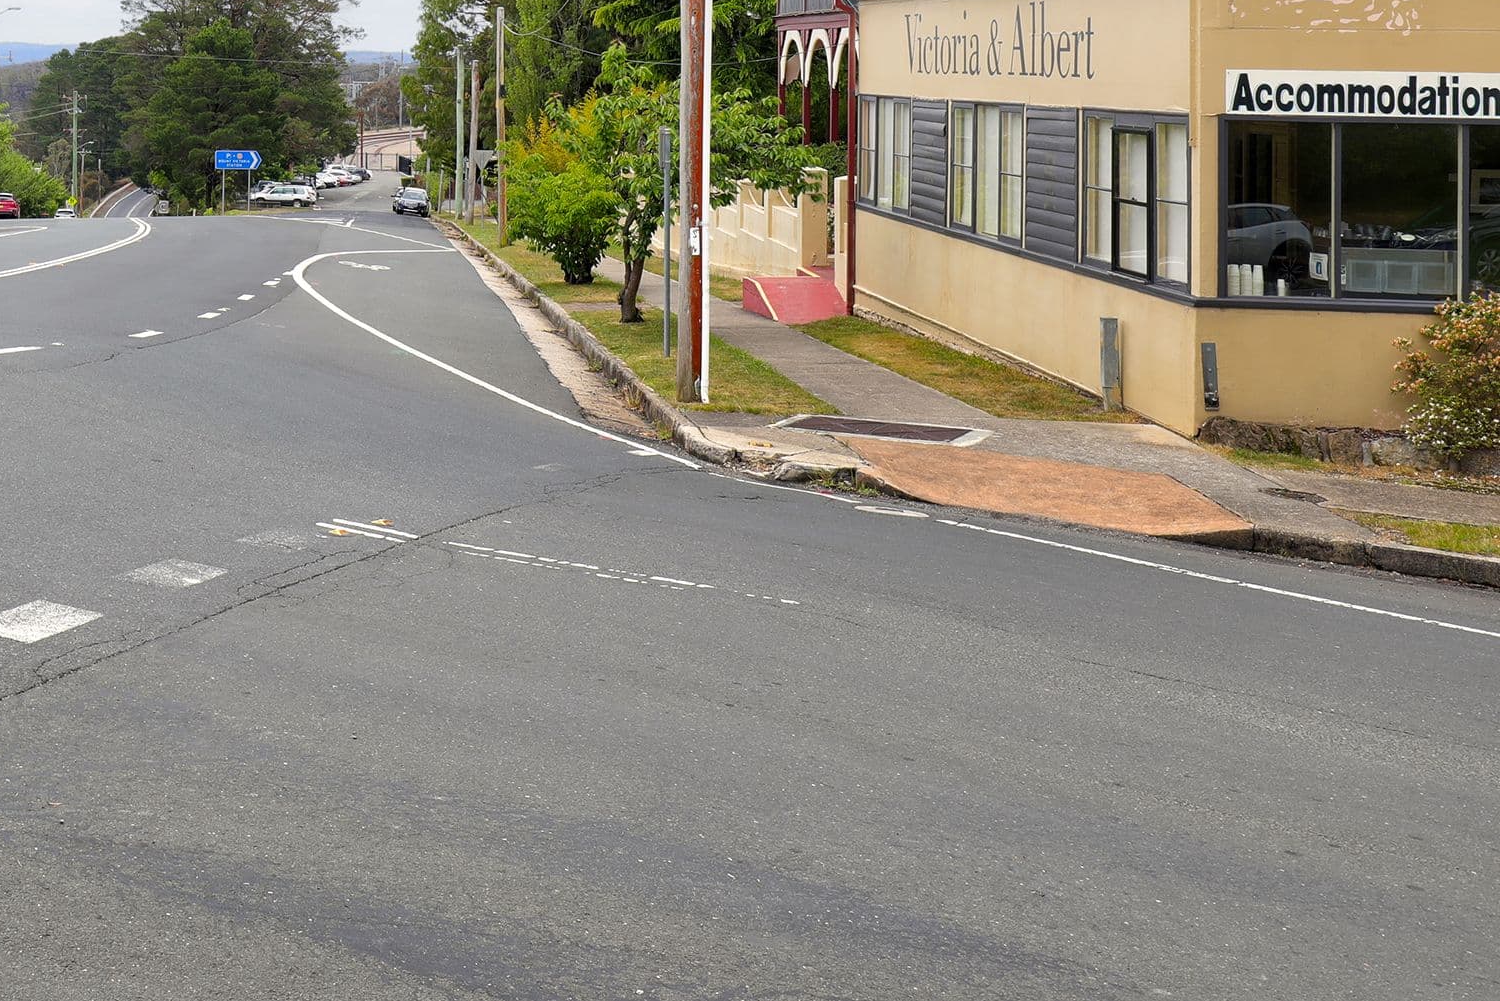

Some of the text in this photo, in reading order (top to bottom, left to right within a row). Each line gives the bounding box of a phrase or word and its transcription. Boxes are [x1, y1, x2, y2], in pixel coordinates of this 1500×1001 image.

[904, 0, 1095, 80] Victoria & Albert
[1232, 72, 1500, 117] Accommodation
